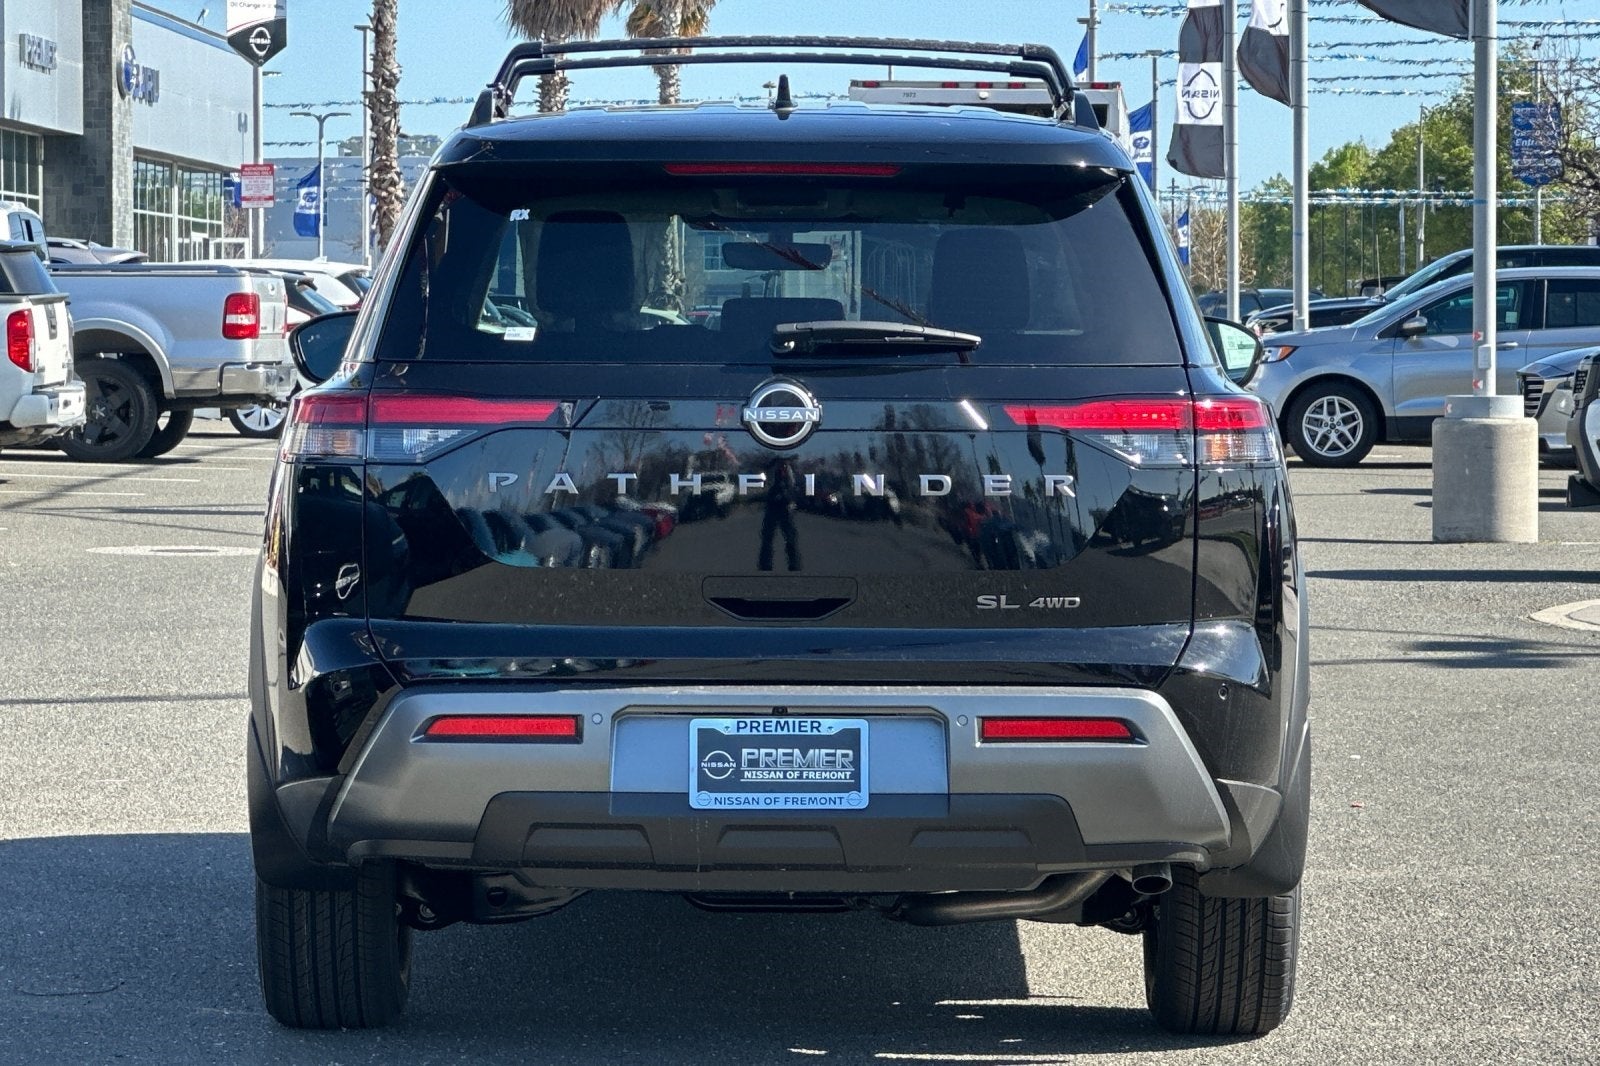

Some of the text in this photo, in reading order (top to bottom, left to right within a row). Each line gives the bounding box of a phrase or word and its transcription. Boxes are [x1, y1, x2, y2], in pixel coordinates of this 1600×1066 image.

[239, 1, 260, 9] Change
[745, 410, 817, 420] NISSAN
[488, 472, 1076, 497] PATHFINDER
[976, 594, 1081, 609] SL 4WD
[736, 720, 822, 733] PREMIER
[741, 748, 854, 769] PREMIER
[744, 770, 852, 779] NISSAN OF FREMONT
[714, 796, 845, 806] NISSAN OF FREMONT
